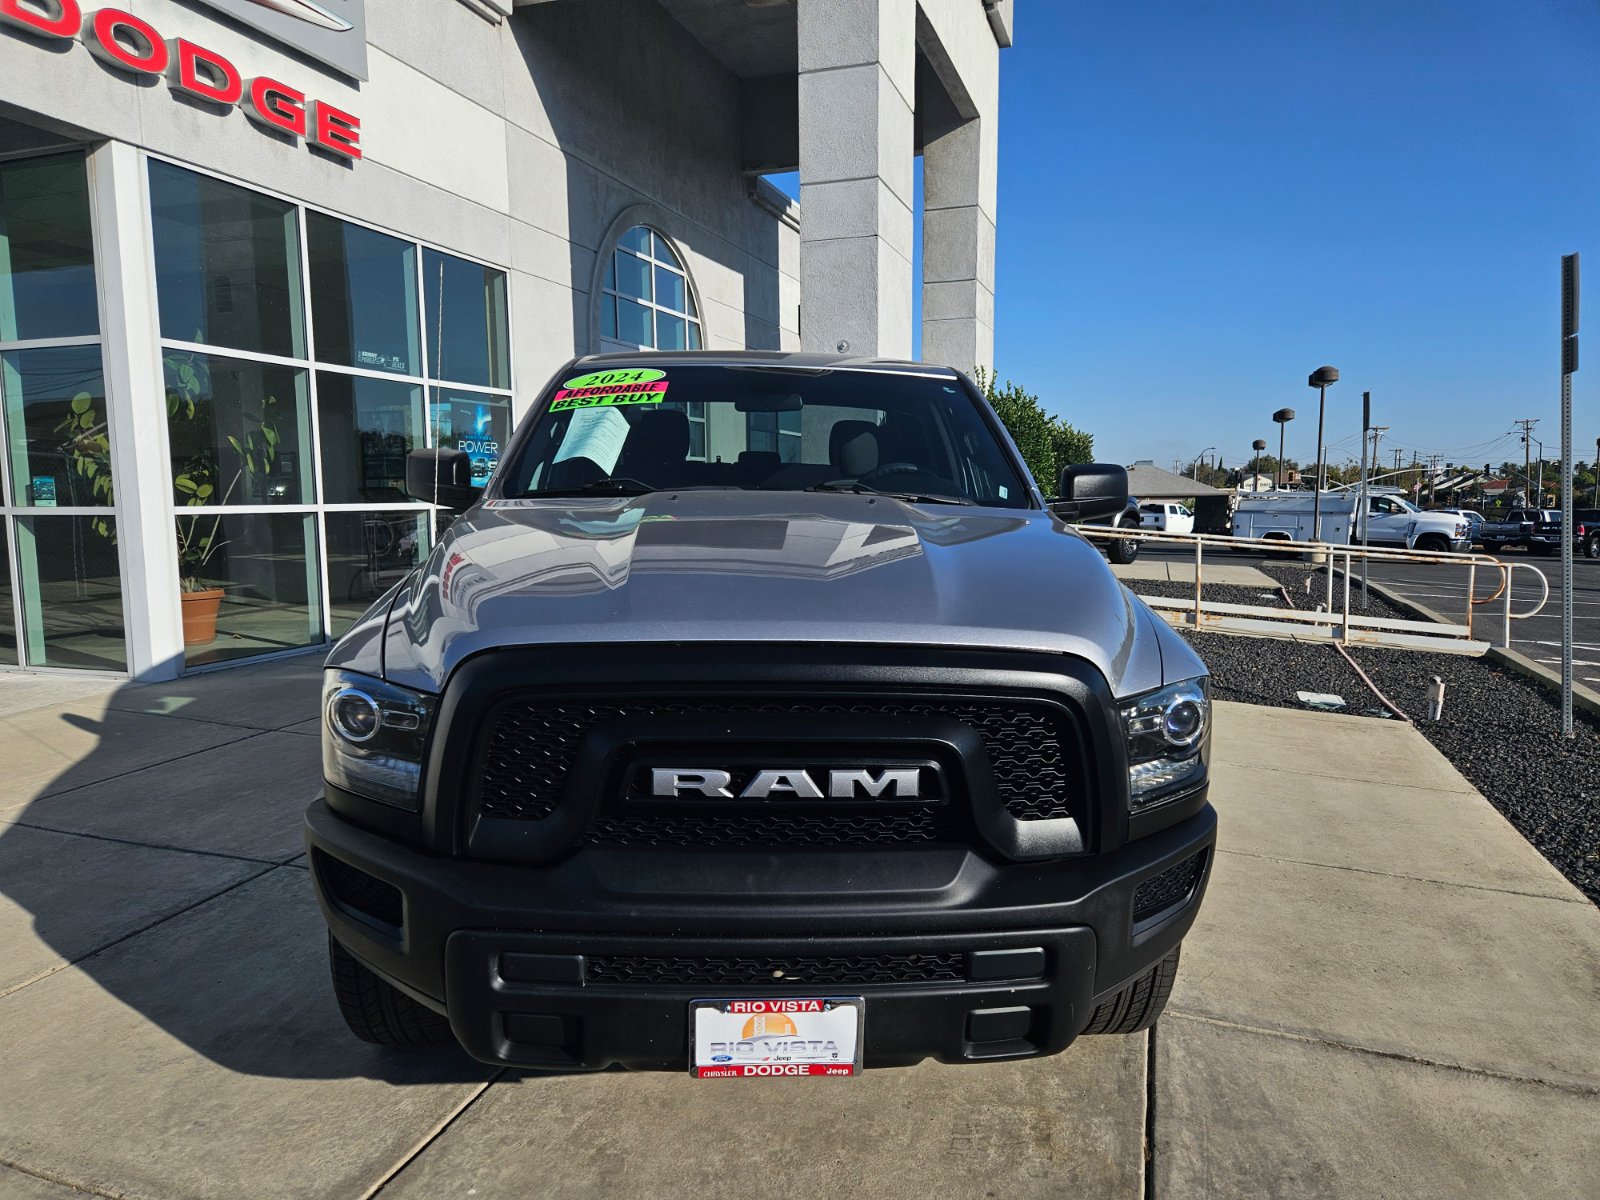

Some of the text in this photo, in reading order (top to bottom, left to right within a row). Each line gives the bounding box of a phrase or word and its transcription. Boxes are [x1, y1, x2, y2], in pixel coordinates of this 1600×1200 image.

[585, 371, 644, 386] 2024
[562, 382, 660, 399] AFFORDABLE
[553, 393, 660, 410] BEST BUY
[458, 440, 498, 454] POWER
[651, 767, 920, 799] RAM
[734, 1001, 820, 1013] RIO VISTA
[710, 1041, 840, 1054] RIO VISTA
[744, 1065, 810, 1077] DODGE
[826, 1067, 849, 1075] Jeep
